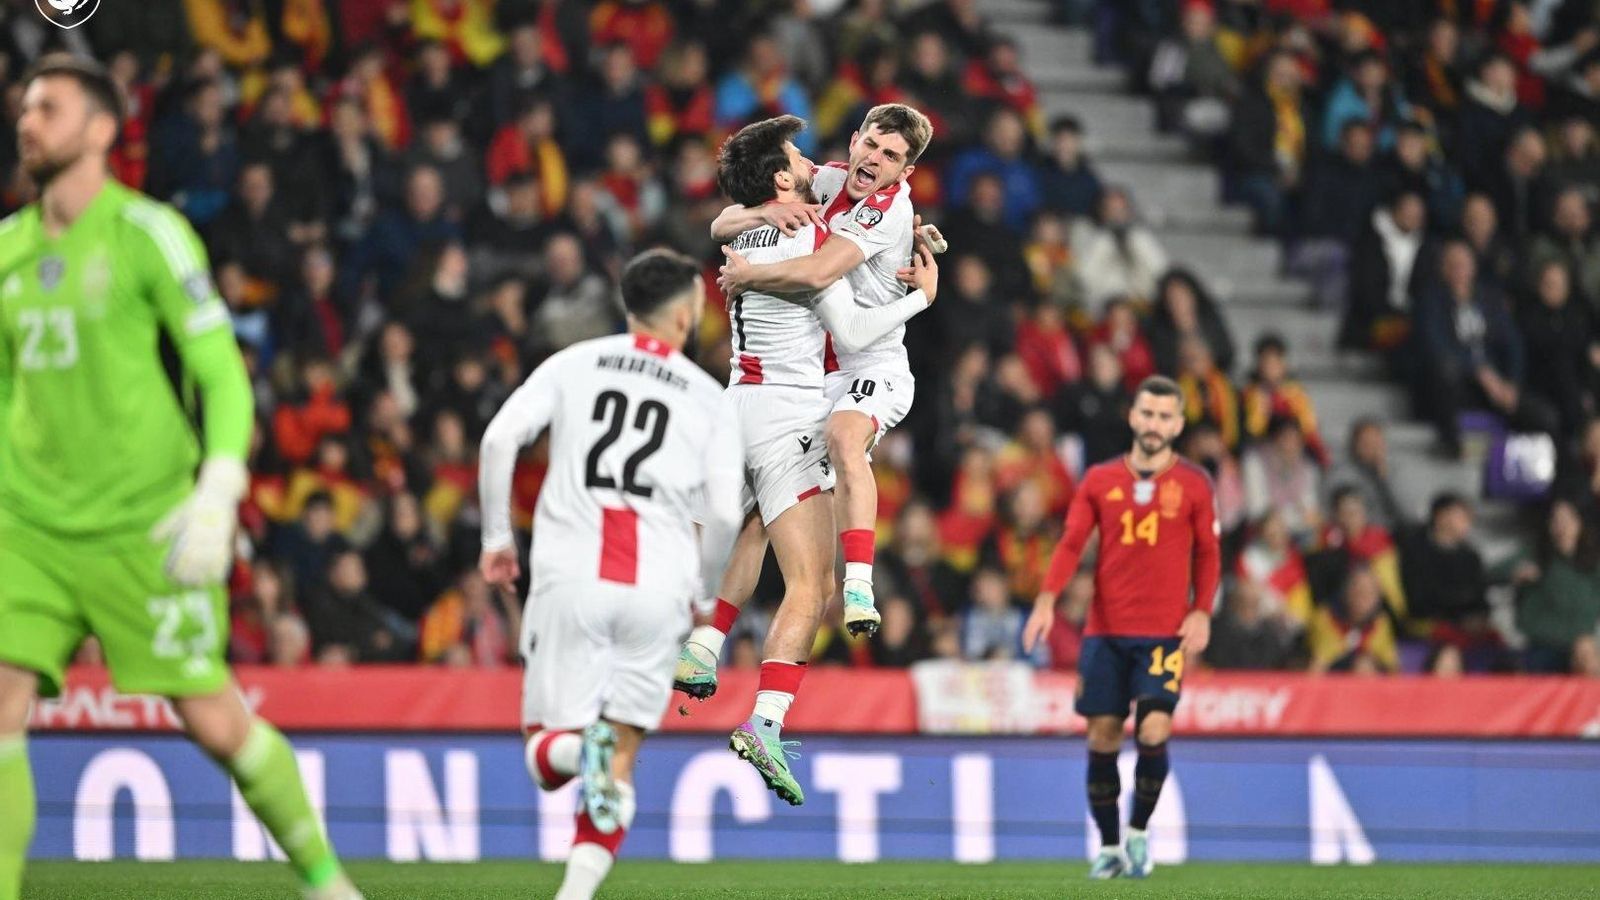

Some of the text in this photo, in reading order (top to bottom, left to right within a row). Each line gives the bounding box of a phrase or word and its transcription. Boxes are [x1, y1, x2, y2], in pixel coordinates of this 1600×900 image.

[18, 309, 79, 371] 23
[847, 378, 876, 397] 10
[585, 390, 669, 498] 22
[1120, 509, 1159, 546] 14
[147, 592, 216, 657] 23
[1148, 645, 1184, 681] 14
